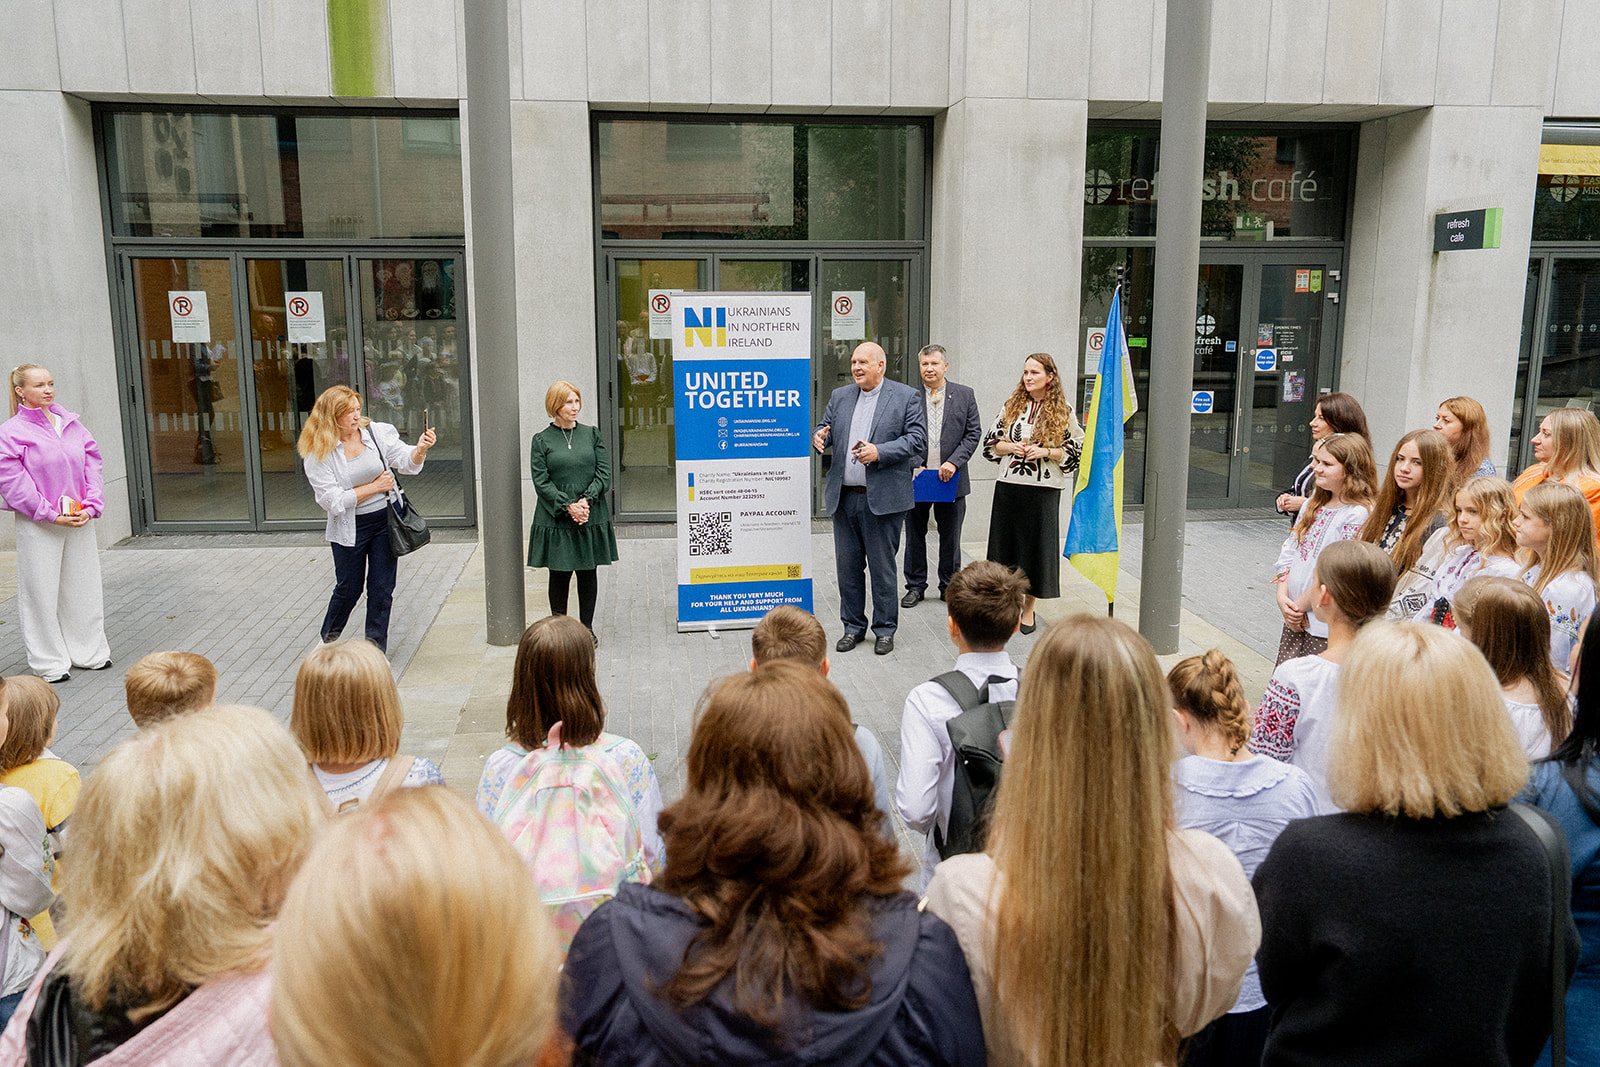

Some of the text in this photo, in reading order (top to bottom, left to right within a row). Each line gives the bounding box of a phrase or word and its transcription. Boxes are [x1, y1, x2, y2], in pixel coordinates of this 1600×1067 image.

[1251, 171, 1317, 202] café
[1447, 218, 1470, 229] refresh
[1450, 232, 1465, 242] cafe
[728, 307, 791, 316] UKRAINIANS
[684, 307, 726, 347] NI
[728, 322, 800, 331] IN NORTHERN
[728, 338, 772, 347] IRELAND
[685, 371, 769, 390] UNITED
[684, 390, 801, 409] TOGETHER
